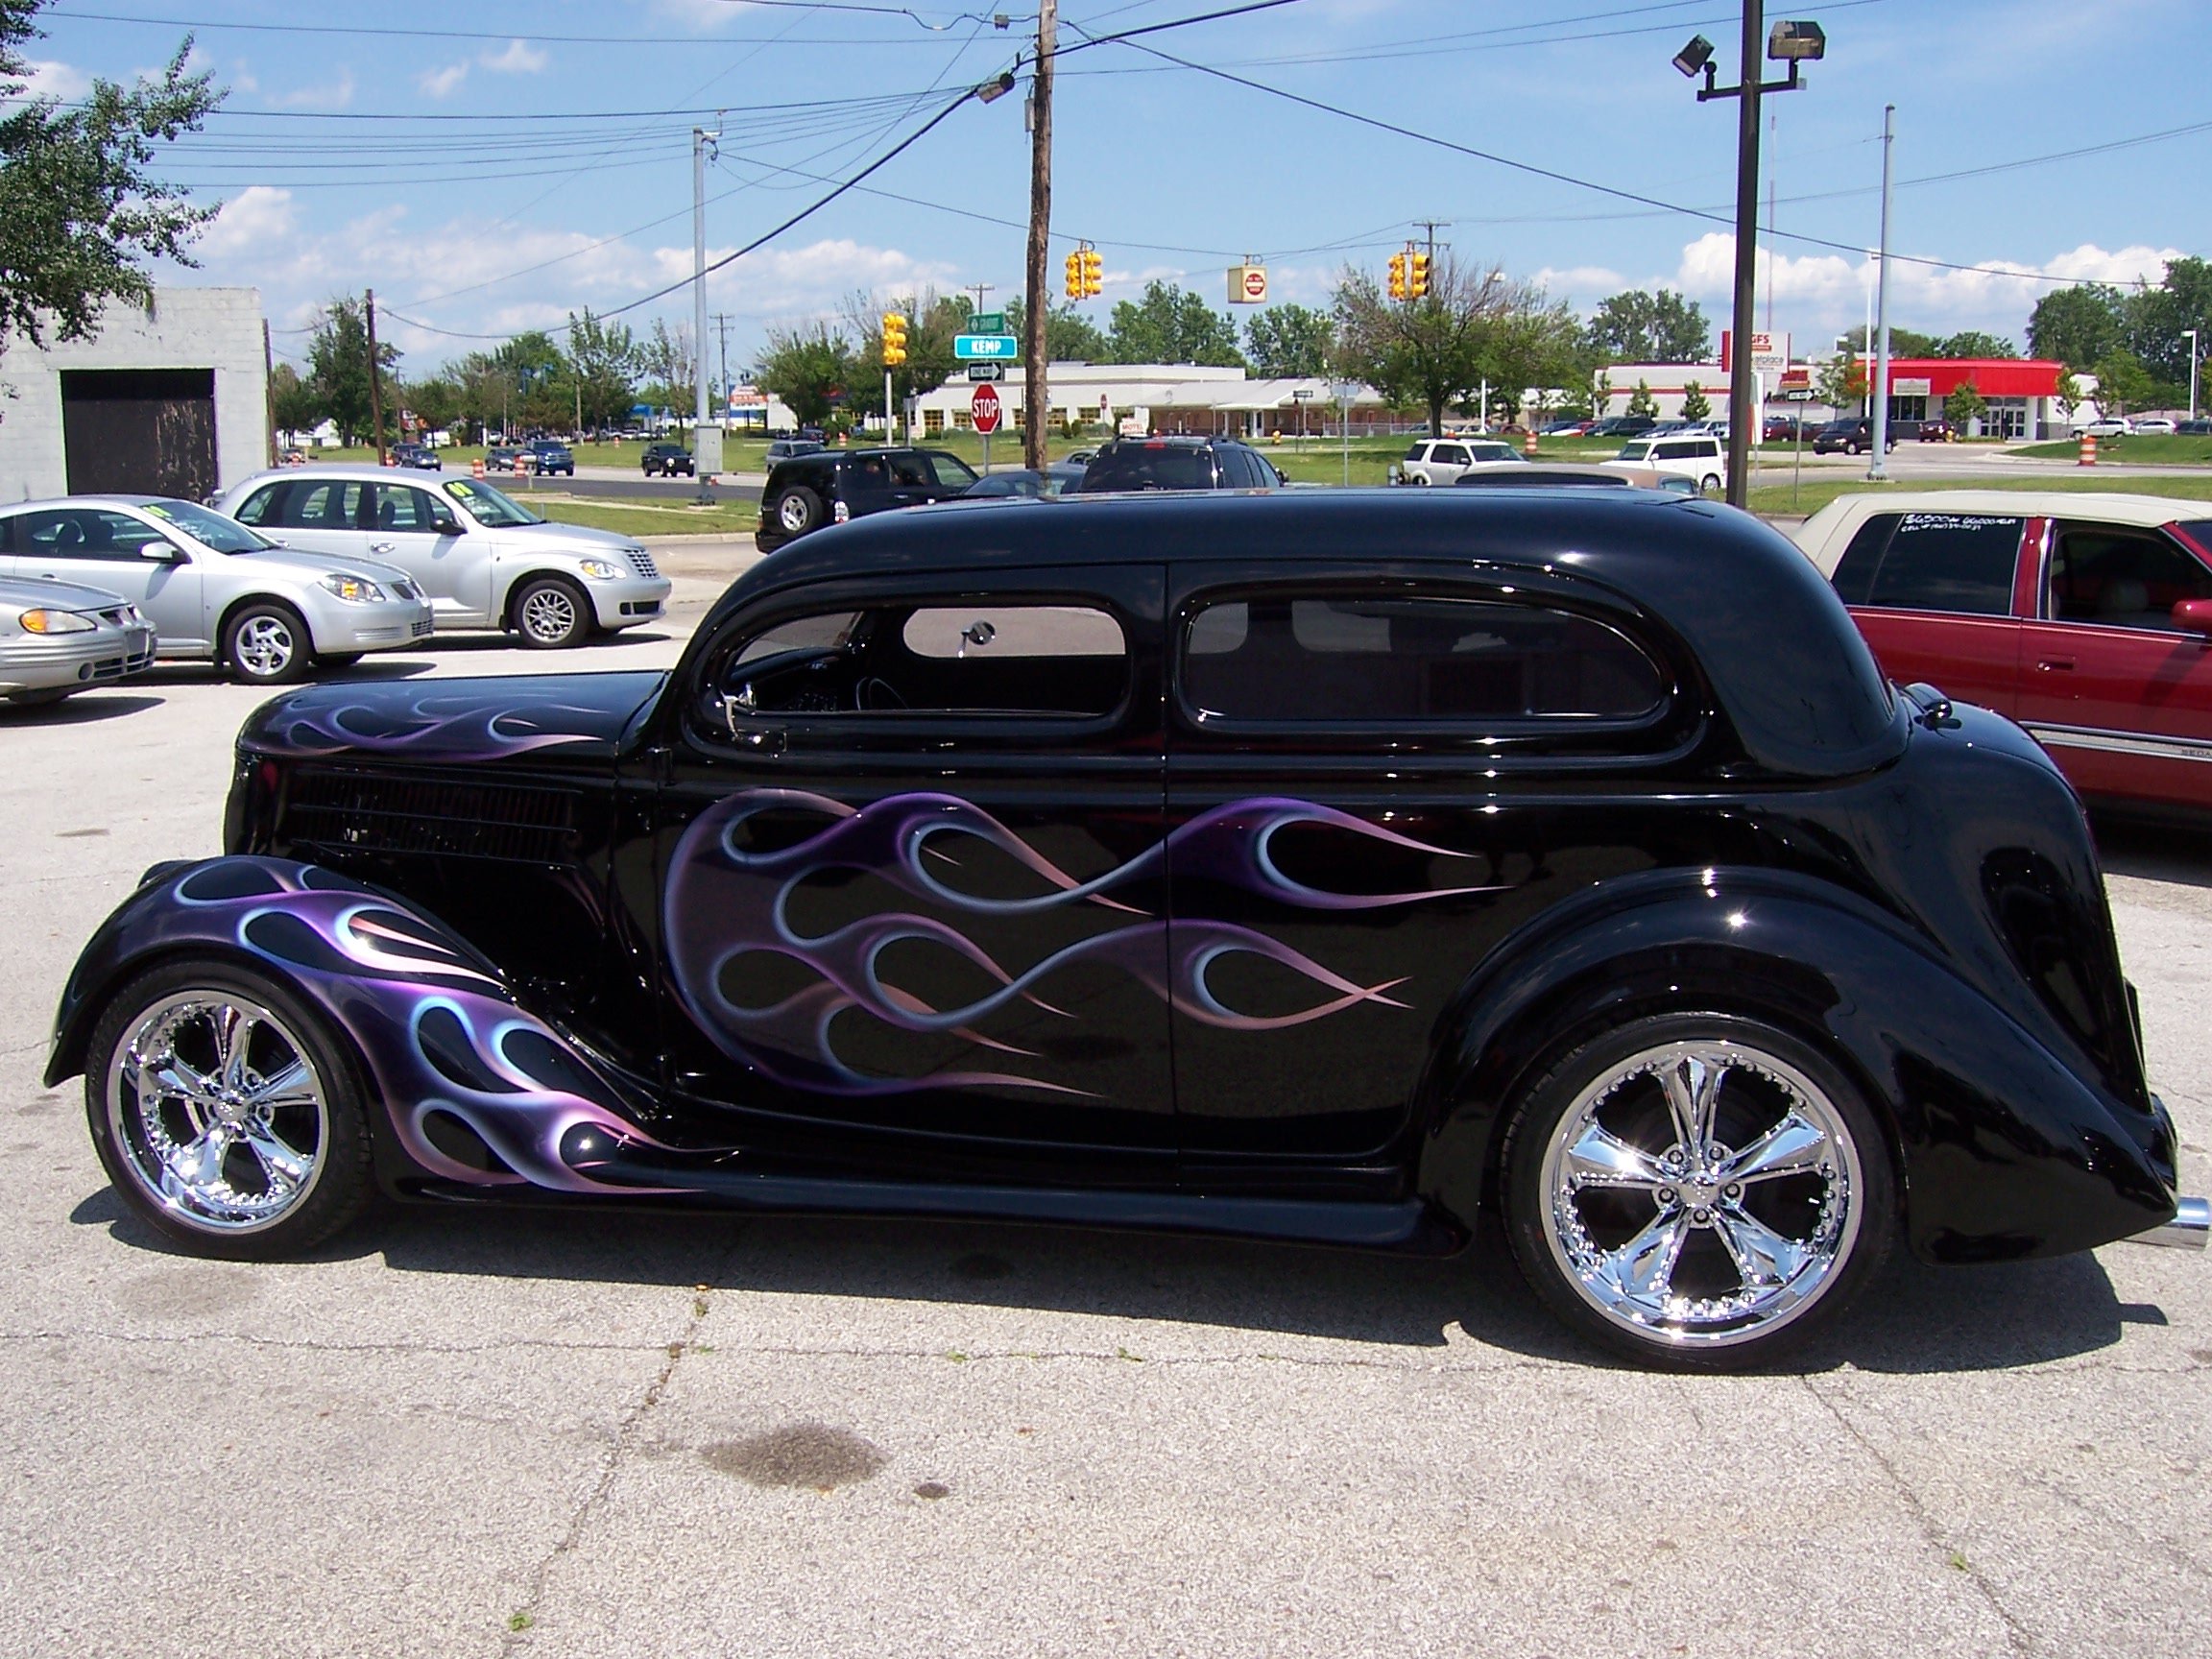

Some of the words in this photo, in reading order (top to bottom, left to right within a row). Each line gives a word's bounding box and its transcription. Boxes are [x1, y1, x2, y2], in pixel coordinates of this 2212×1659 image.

[1751, 334, 1769, 344] GFS
[971, 340, 1001, 354] KEMP
[974, 398, 998, 418] STOP
